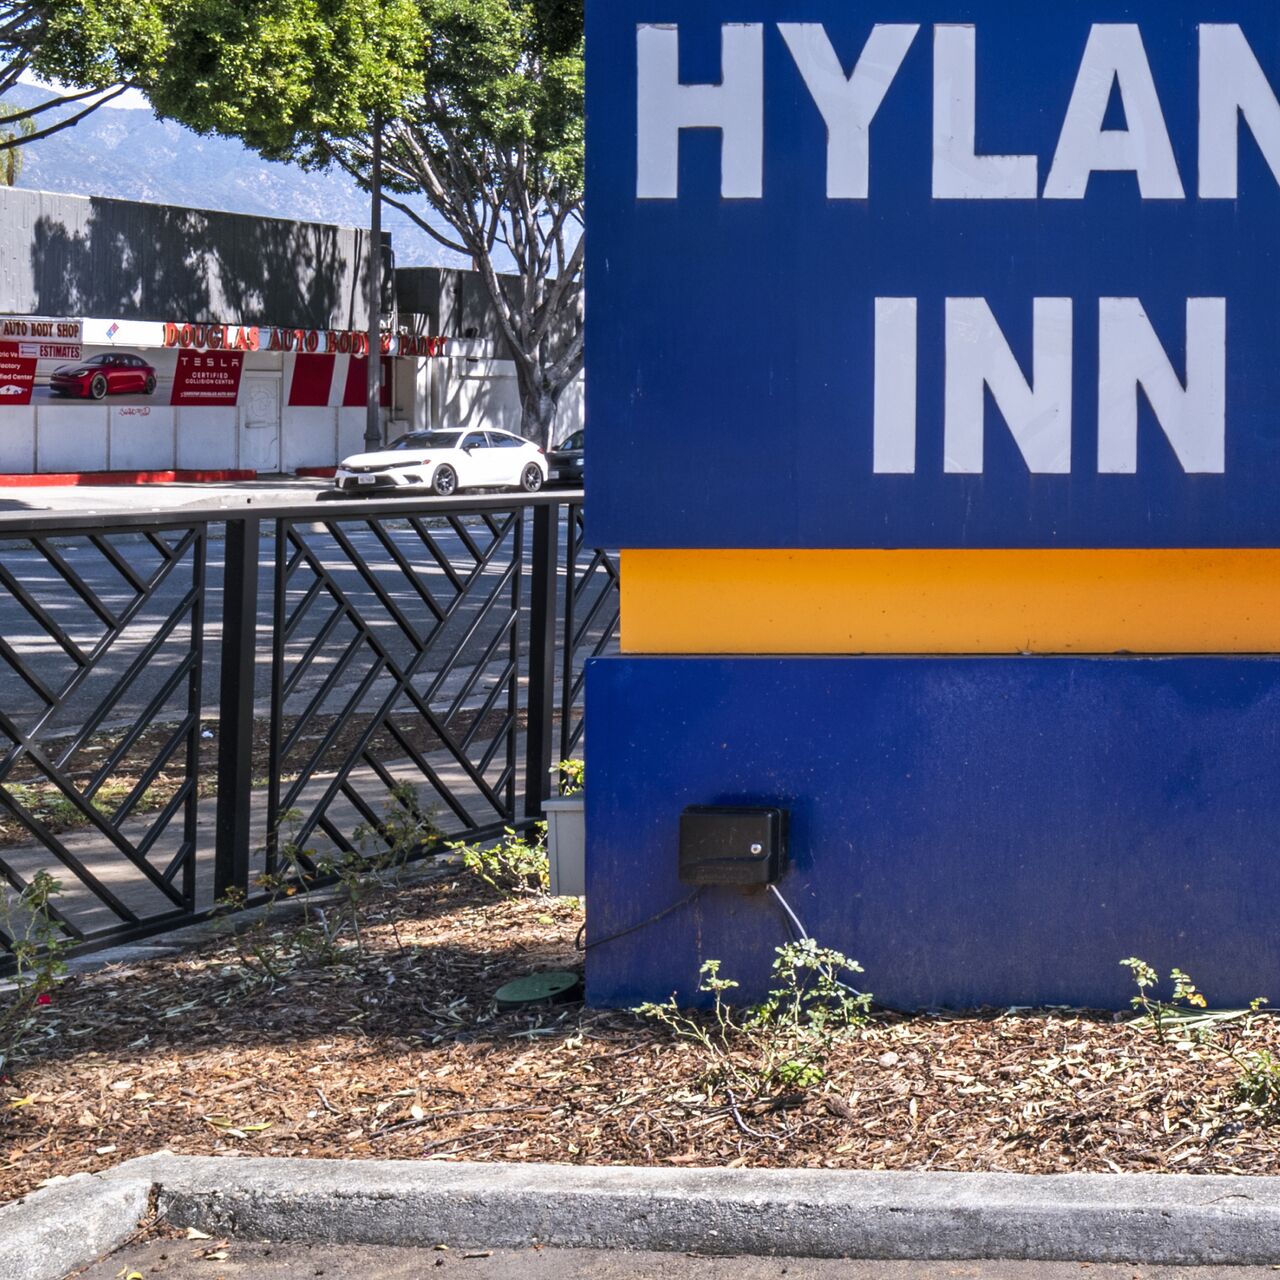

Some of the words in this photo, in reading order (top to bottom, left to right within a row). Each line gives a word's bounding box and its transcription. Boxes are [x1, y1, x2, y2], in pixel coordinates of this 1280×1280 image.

[3, 321, 28, 337] AUTO
[30, 322, 54, 337] BODY
[56, 323, 79, 338] SHOP
[163, 322, 260, 351] DOUGLAS
[268, 328, 319, 352] AUTO
[40, 345, 80, 358] ESTIMATES
[181, 357, 239, 367] TESLA
[192, 371, 229, 379] CERTIFIED
[873, 296, 1226, 473] INN
